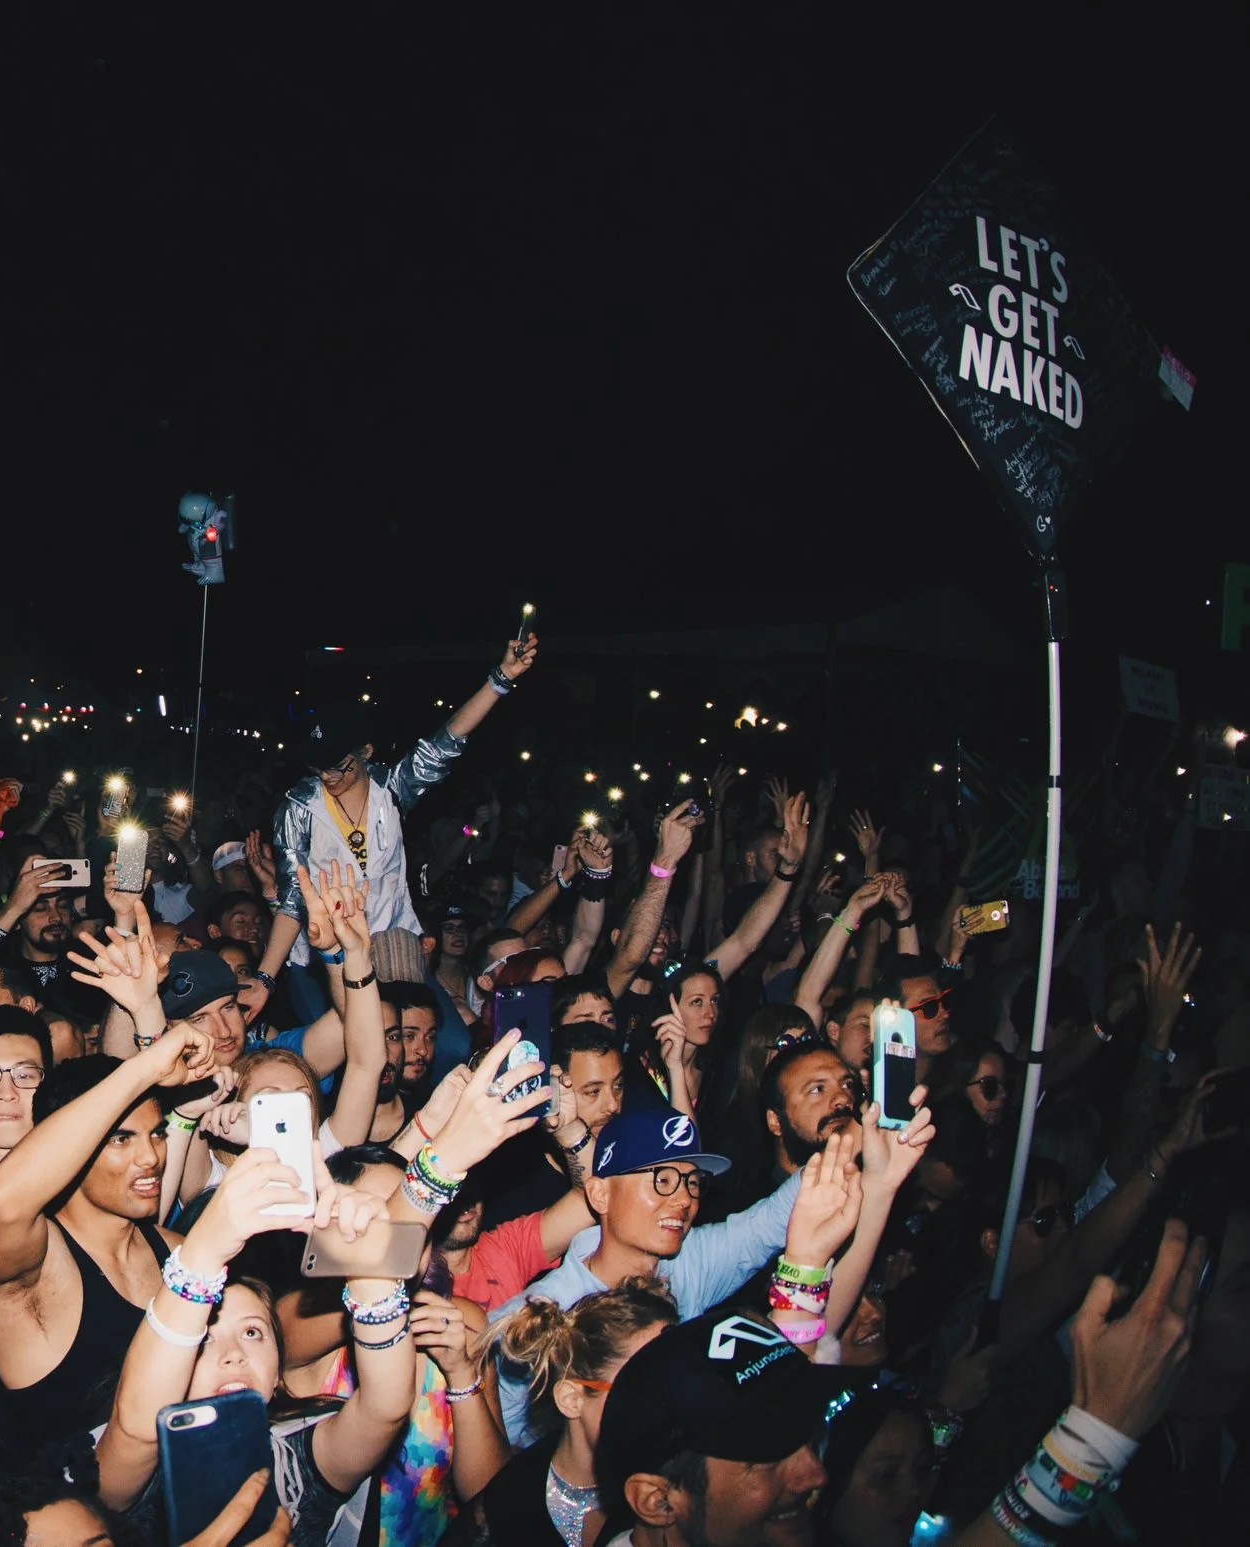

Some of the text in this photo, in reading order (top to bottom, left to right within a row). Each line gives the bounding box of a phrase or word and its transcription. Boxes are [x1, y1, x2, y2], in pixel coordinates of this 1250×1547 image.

[976, 216, 1068, 303] LET'S
[988, 284, 1059, 357] GET
[959, 324, 1083, 429] NAKED
[1016, 859, 1067, 880] Abe
